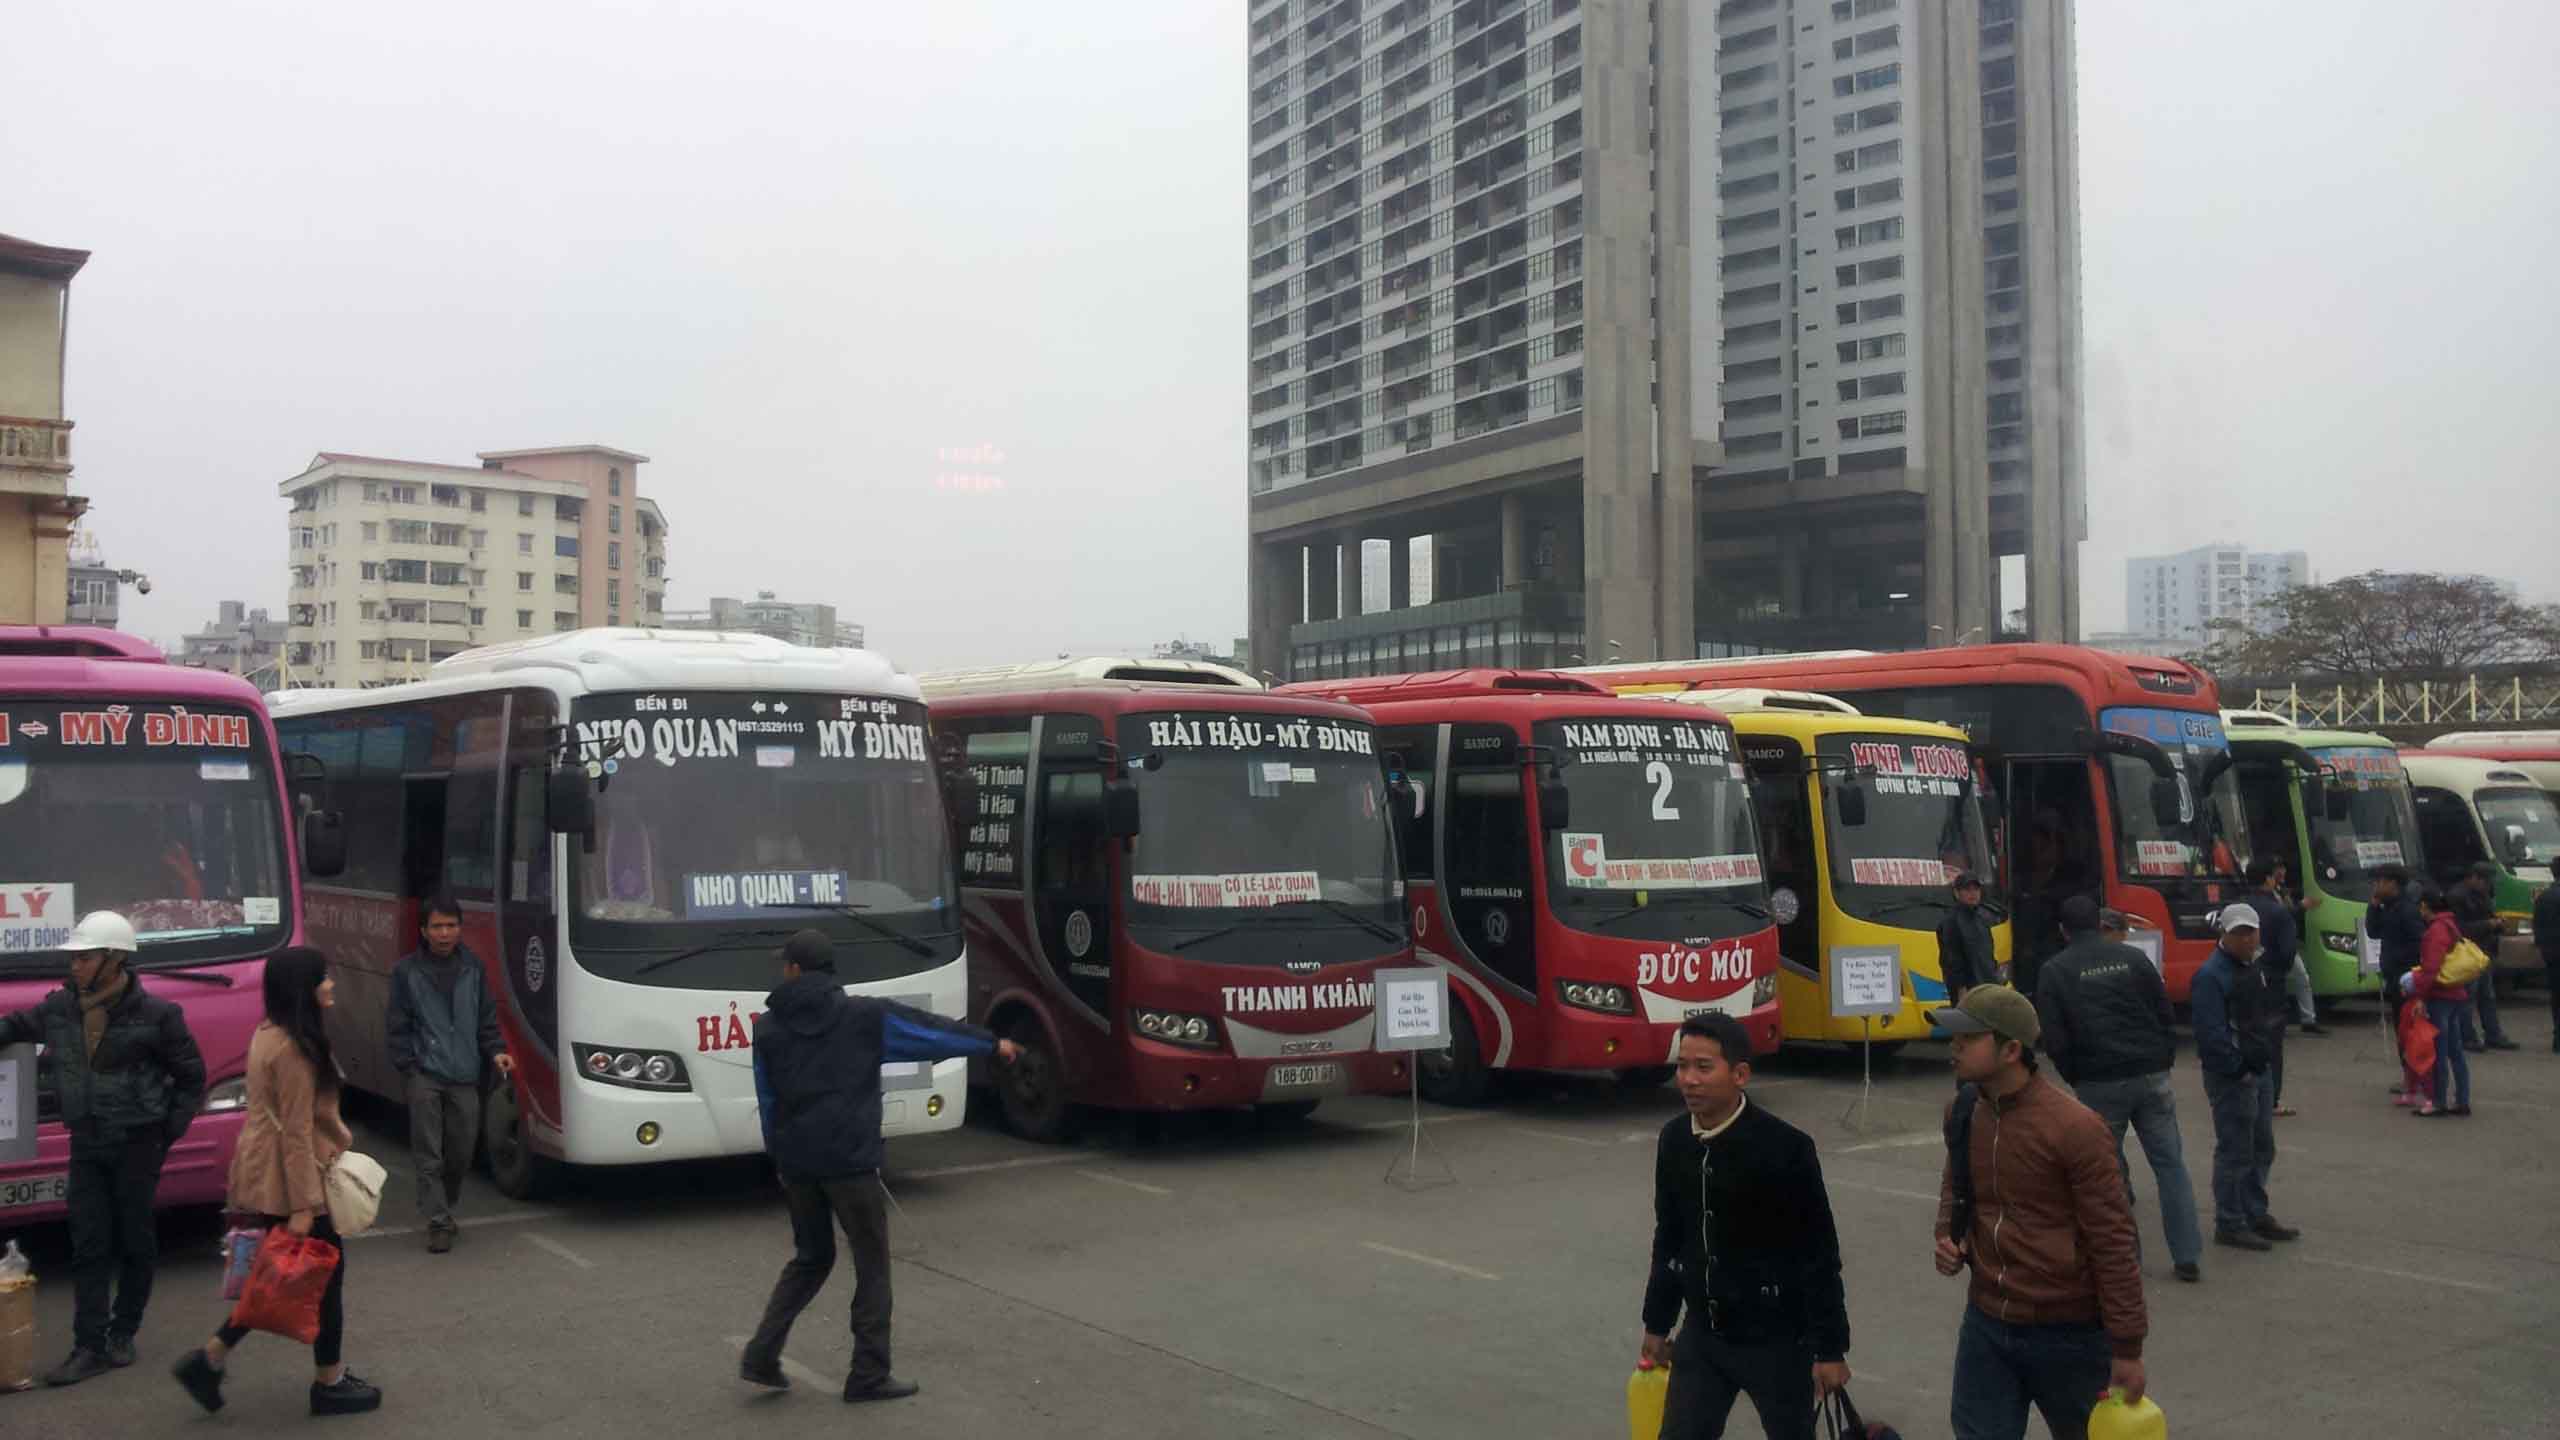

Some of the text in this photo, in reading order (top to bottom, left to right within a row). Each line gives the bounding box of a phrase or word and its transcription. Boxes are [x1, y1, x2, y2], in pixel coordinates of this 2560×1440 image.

[635, 695, 688, 711] BẾN ĐI
[60, 704, 250, 748] MỸ ĐÌNH
[576, 718, 646, 761] NHO
[652, 717, 739, 767] QUAN
[817, 711, 926, 761] MỸ ĐÌNH
[1149, 713, 1202, 747] HẢI
[1207, 715, 1261, 750] HẬU
[1276, 718, 1311, 748] MỸ
[1317, 720, 1372, 755] ĐÌNH
[1562, 724, 1611, 748] NAM
[1612, 724, 1662, 753] ĐỊNH
[1672, 722, 1700, 750] HÀ
[1700, 726, 1729, 756] NỘI
[1851, 742, 1903, 775] MINH
[1646, 761, 1680, 820] 2
[694, 875, 736, 907] NHO
[742, 874, 795, 908] QUAN
[812, 873, 841, 903] ME
[1637, 940, 1753, 985] ĐỨC MỚI
[1222, 977, 1376, 1012] THANH KHÂM
[697, 1001, 762, 1052] HẢ
